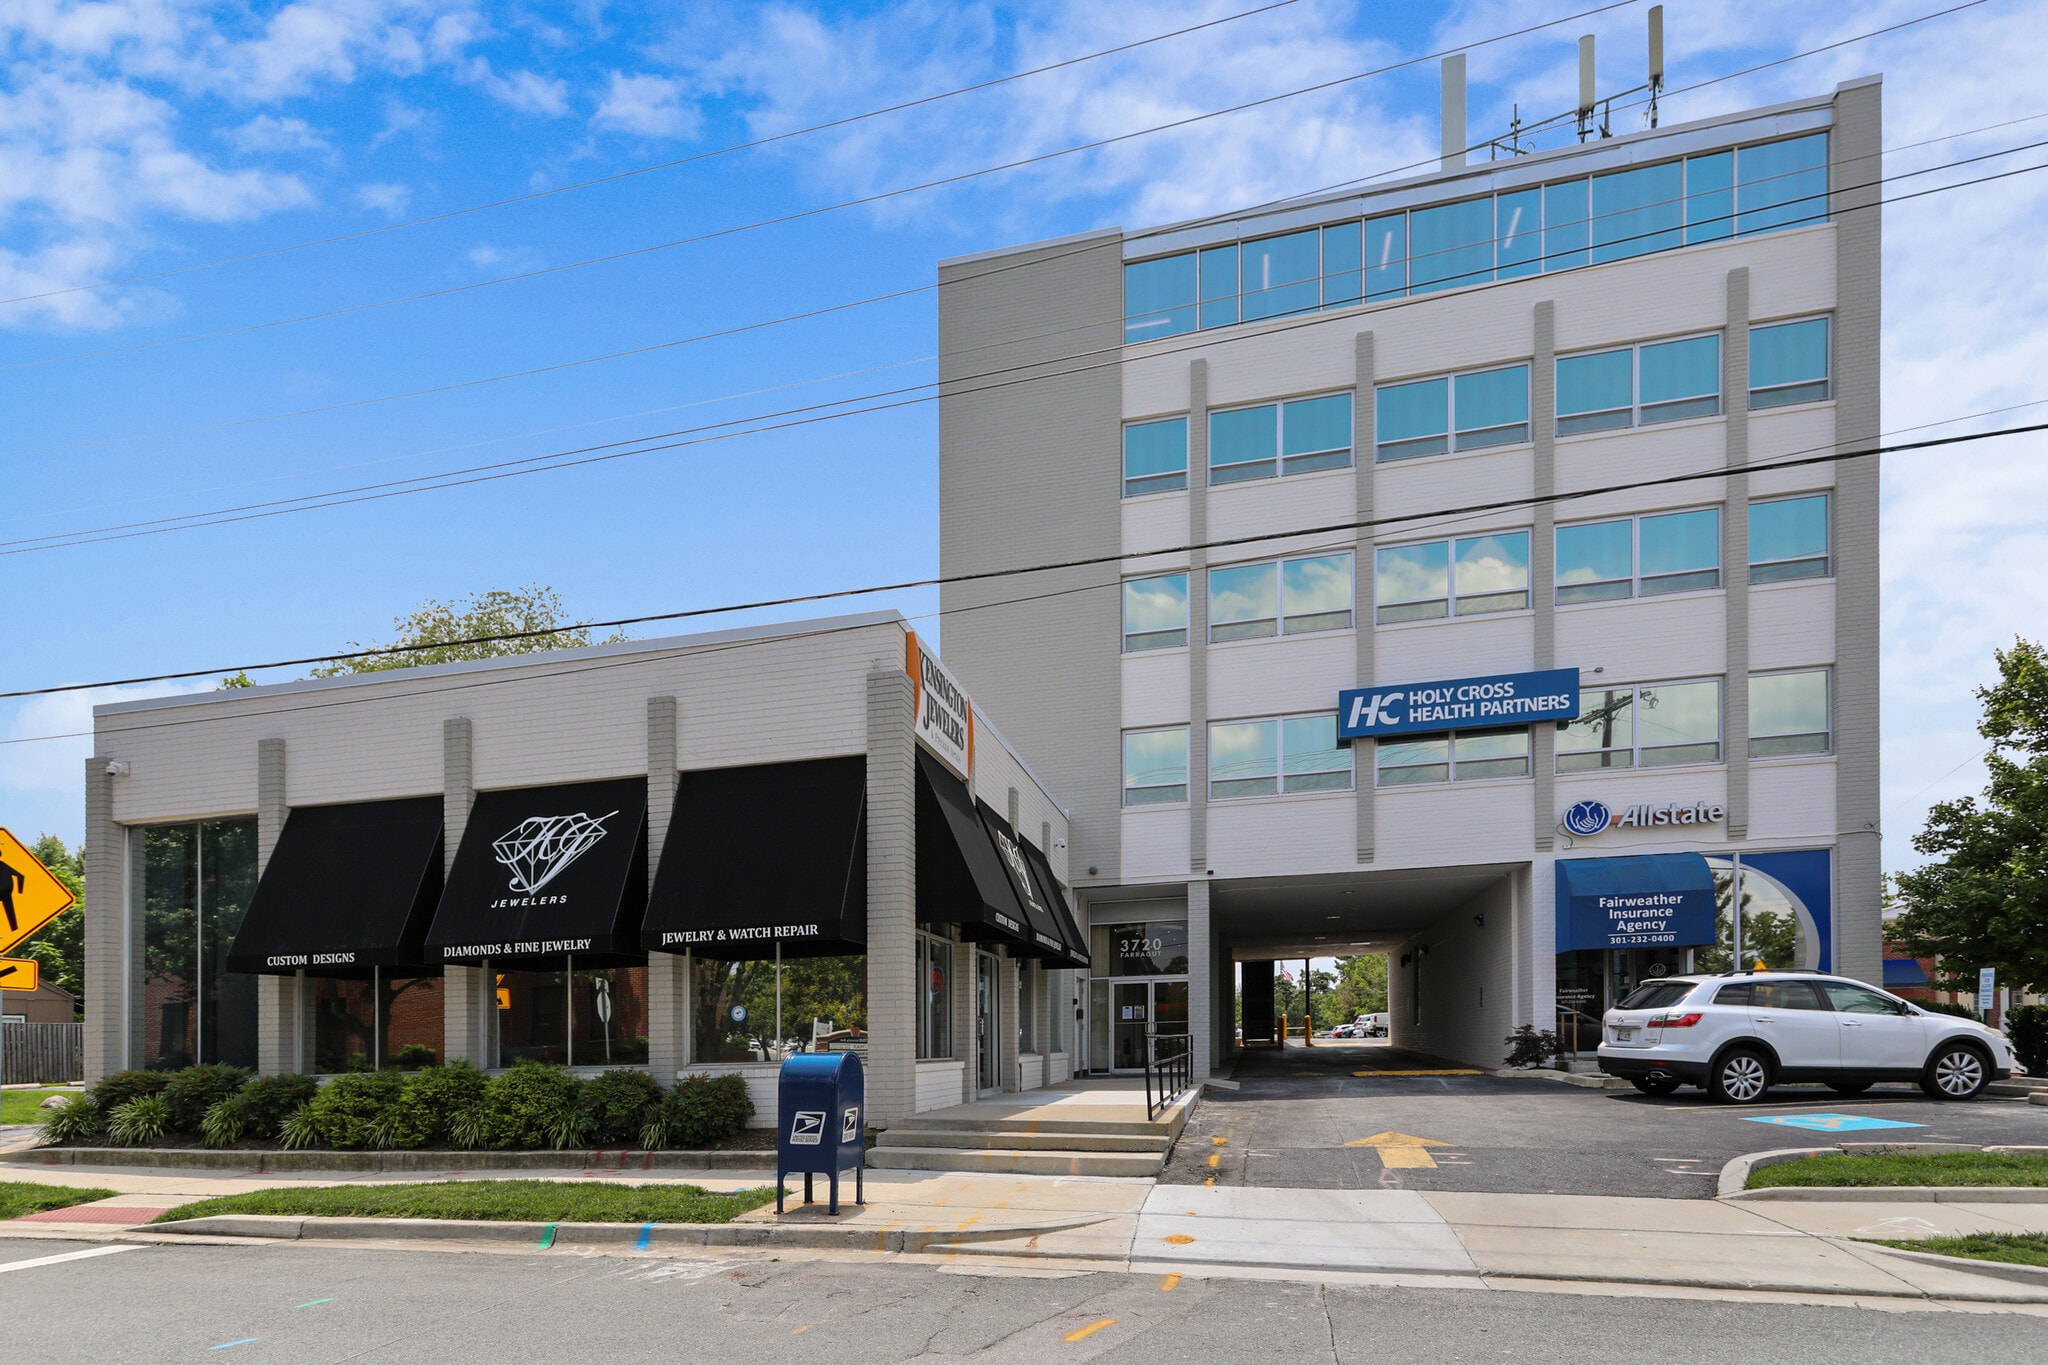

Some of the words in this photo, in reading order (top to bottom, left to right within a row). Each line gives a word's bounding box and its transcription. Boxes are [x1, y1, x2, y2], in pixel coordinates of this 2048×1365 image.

[918, 646, 968, 723] KENSINGTON
[1409, 687, 1454, 706] HOLY
[1457, 682, 1514, 701] CROSS
[1347, 693, 1404, 728] HC
[1409, 703, 1474, 723] HEALTH
[1480, 694, 1571, 716] PARTNERS
[923, 690, 965, 751] JEWELERS
[1616, 800, 1725, 829] Allstate
[490, 895, 568, 908] JEWELERS
[1600, 893, 1683, 908] Fairweather
[1609, 907, 1673, 919] Insurance
[1616, 919, 1666, 932] Agency
[662, 930, 715, 946] JEWELRY
[716, 929, 727, 941] &
[729, 926, 771, 940] WATCH
[774, 924, 819, 937] REPAIR
[1610, 934, 1675, 945] 301-232-0400
[443, 943, 502, 957] DIAMONDS
[503, 943, 513, 954] &
[514, 942, 540, 954] FINE
[541, 938, 592, 954] JEWELRY
[1121, 938, 1162, 952] 3720
[267, 955, 308, 966] CUSTOM
[312, 952, 355, 964] DESIGNS
[1120, 950, 1162, 958] FARRAGUT
